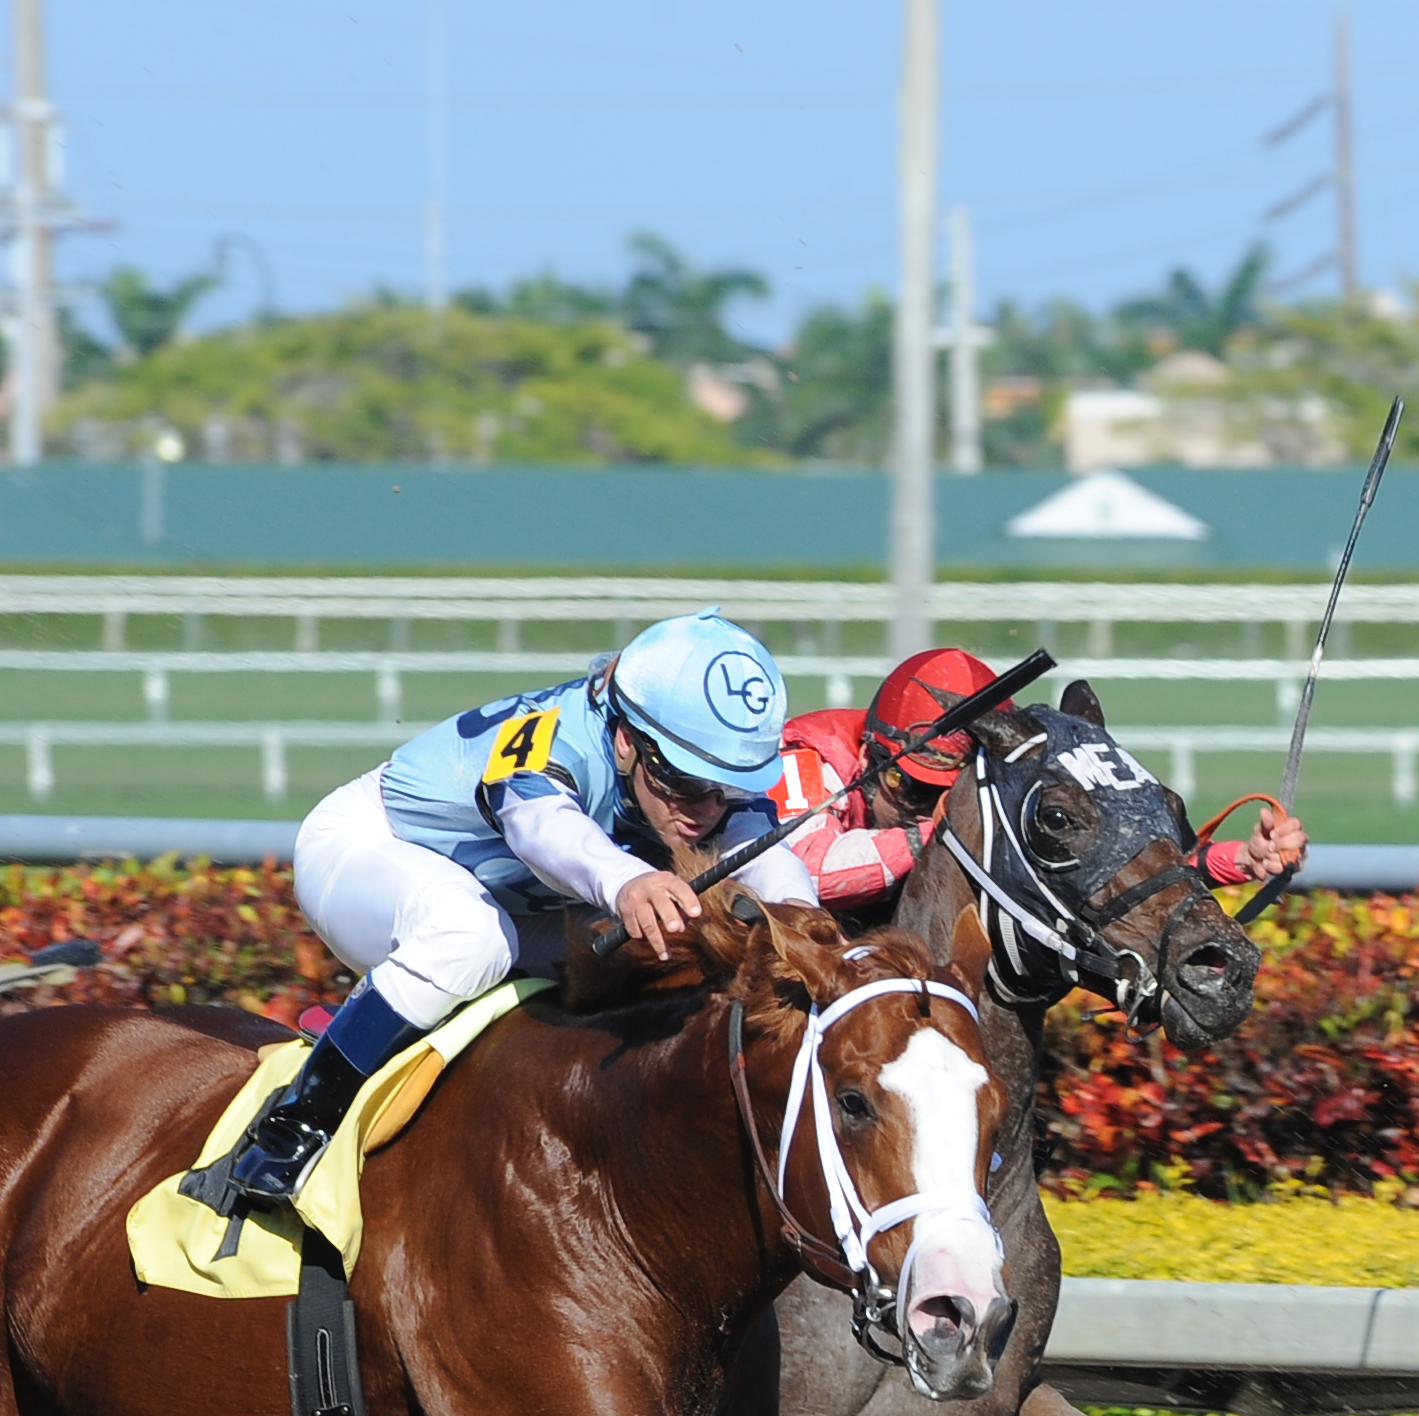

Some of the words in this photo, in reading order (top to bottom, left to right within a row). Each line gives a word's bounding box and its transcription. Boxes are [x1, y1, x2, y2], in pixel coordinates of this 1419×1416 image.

[720, 663, 769, 715] LG
[500, 715, 543, 768] 4
[782, 754, 809, 809] 1
